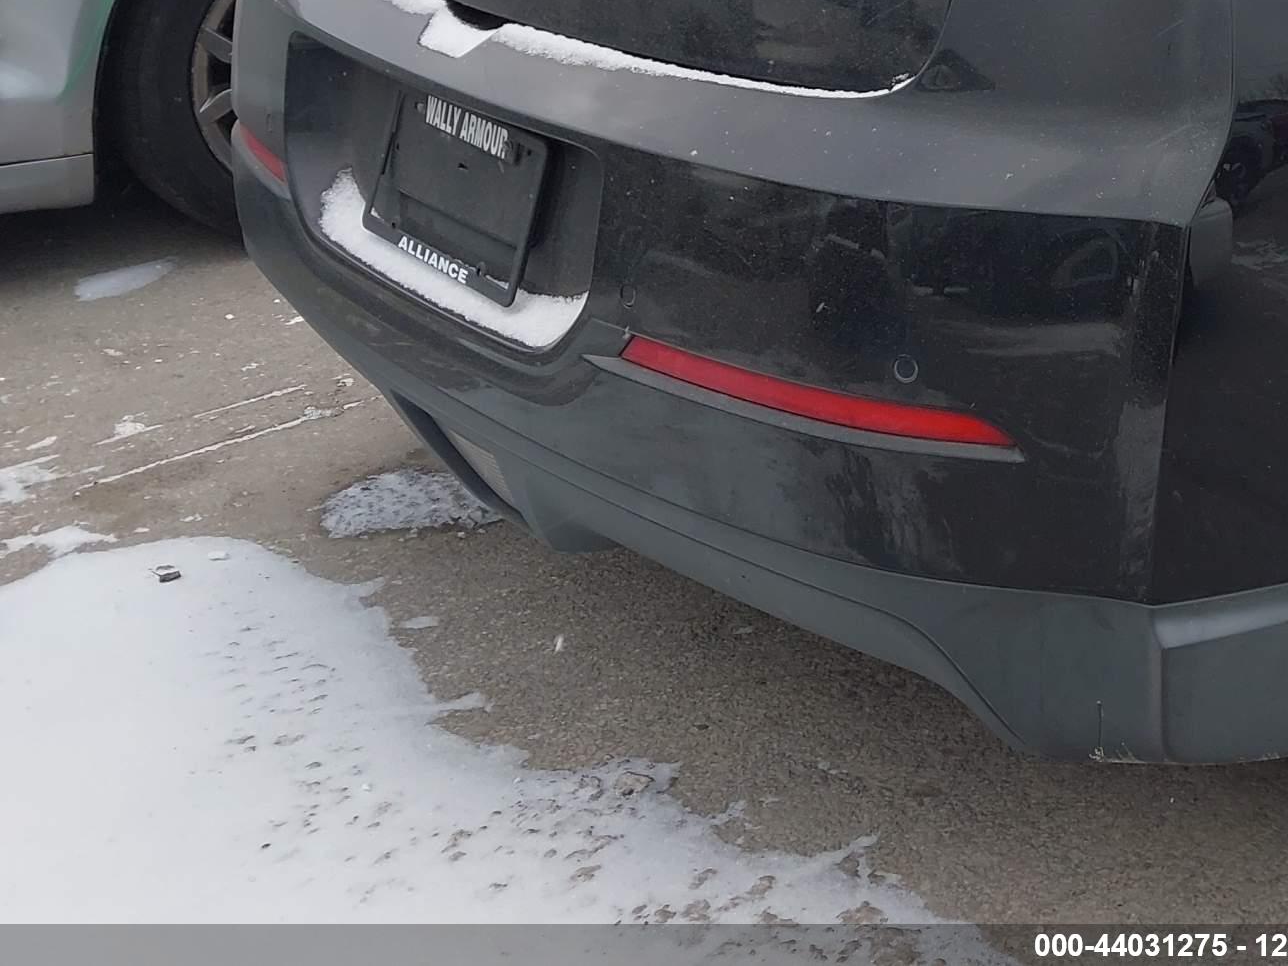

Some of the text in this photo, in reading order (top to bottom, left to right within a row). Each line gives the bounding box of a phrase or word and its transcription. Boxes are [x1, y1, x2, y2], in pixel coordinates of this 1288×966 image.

[425, 95, 509, 159] WALLY ARMOUR
[398, 235, 469, 284] ALLIANCE
